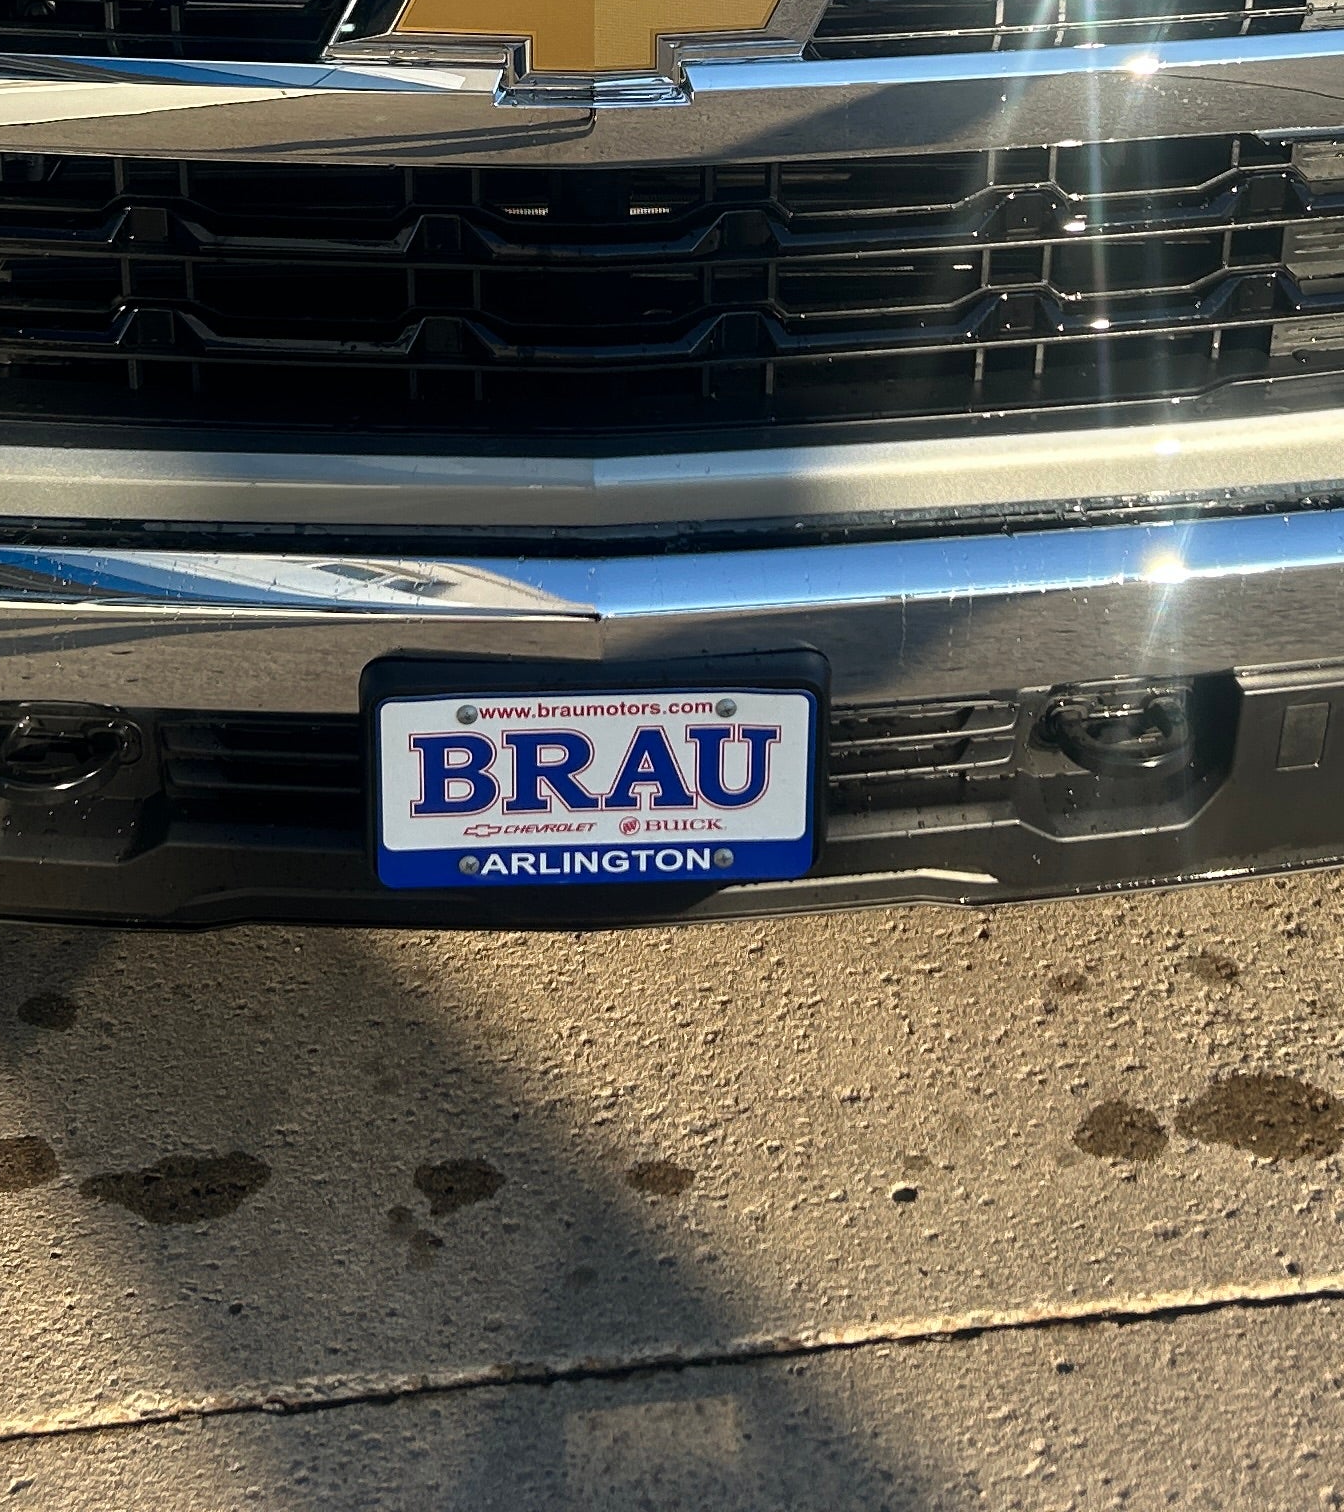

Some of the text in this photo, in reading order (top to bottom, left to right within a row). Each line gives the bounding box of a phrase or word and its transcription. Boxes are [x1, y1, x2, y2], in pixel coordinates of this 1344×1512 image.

[479, 701, 713, 719] www.braumotors.com
[408, 723, 781, 818] BRAU
[503, 818, 722, 834] CHEVROLET BUICK
[480, 848, 711, 875] ARLINGTON
